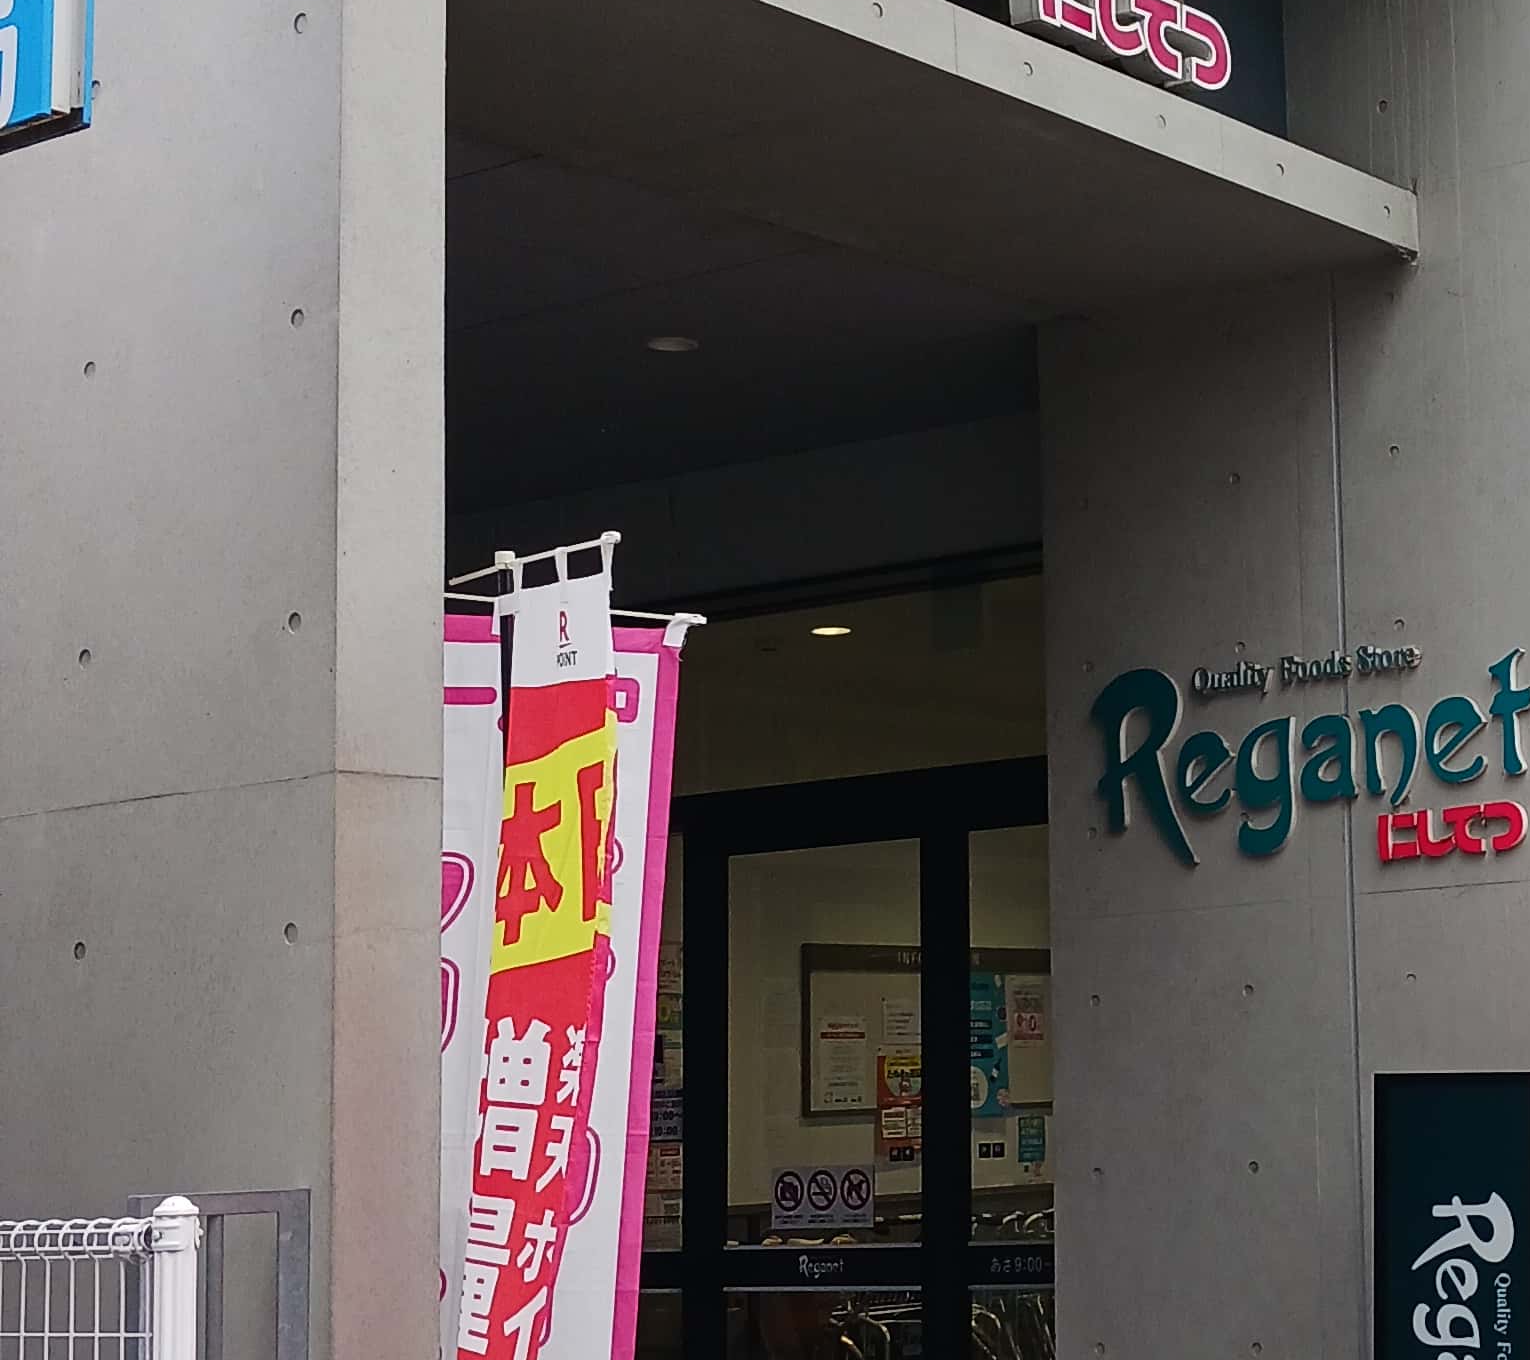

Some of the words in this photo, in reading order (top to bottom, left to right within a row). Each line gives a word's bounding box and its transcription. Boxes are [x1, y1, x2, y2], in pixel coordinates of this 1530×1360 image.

[1191, 661, 1274, 696] Quality
[1280, 649, 1352, 683] Foods
[1356, 644, 1423, 675] Store
[1494, 1272, 1512, 1335] Quality
